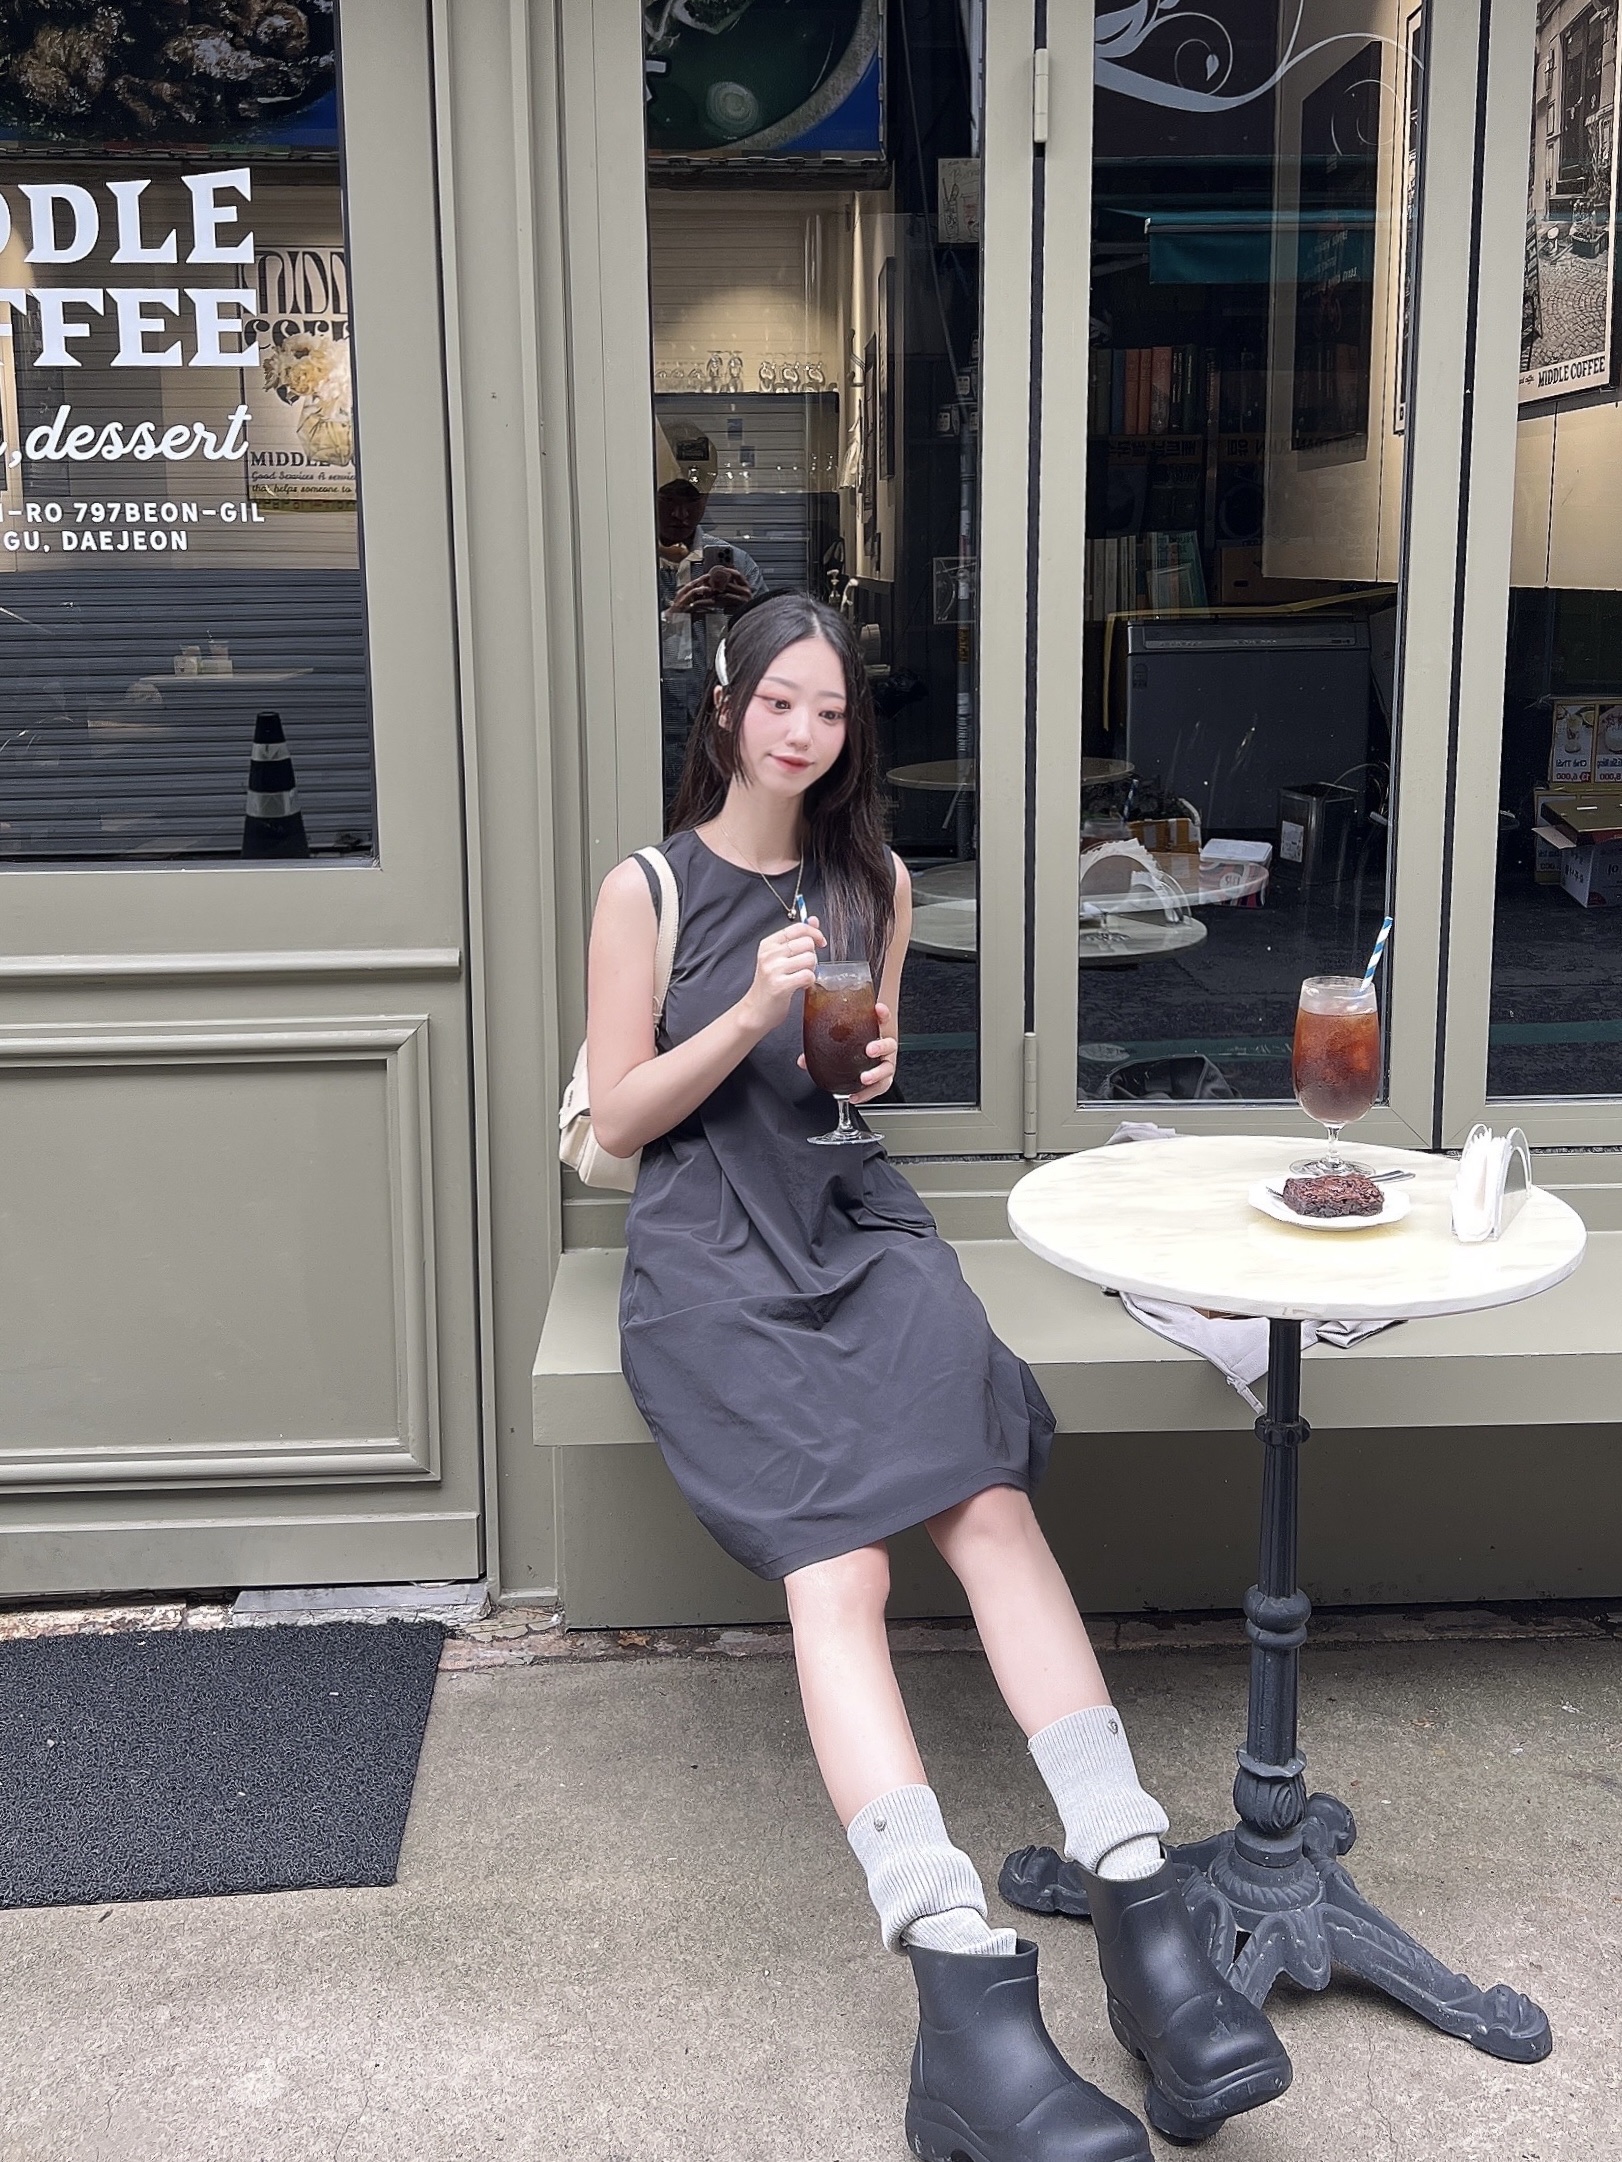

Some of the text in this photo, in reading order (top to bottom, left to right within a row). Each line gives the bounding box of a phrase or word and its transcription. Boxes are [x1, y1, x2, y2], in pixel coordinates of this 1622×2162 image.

[0, 168, 255, 264] DLE
[1537, 364, 1569, 388] MIDDLE
[1570, 355, 1606, 380] COFFEE
[0, 404, 252, 469] ,dessert
[252, 471, 276, 482] Good
[278, 471, 314, 481] Services
[273, 484, 298, 495] helps
[300, 485, 339, 493] someone
[73, 501, 266, 524] 797BEON-GIL
[3, 530, 188, 554] GU, DAEJEON
